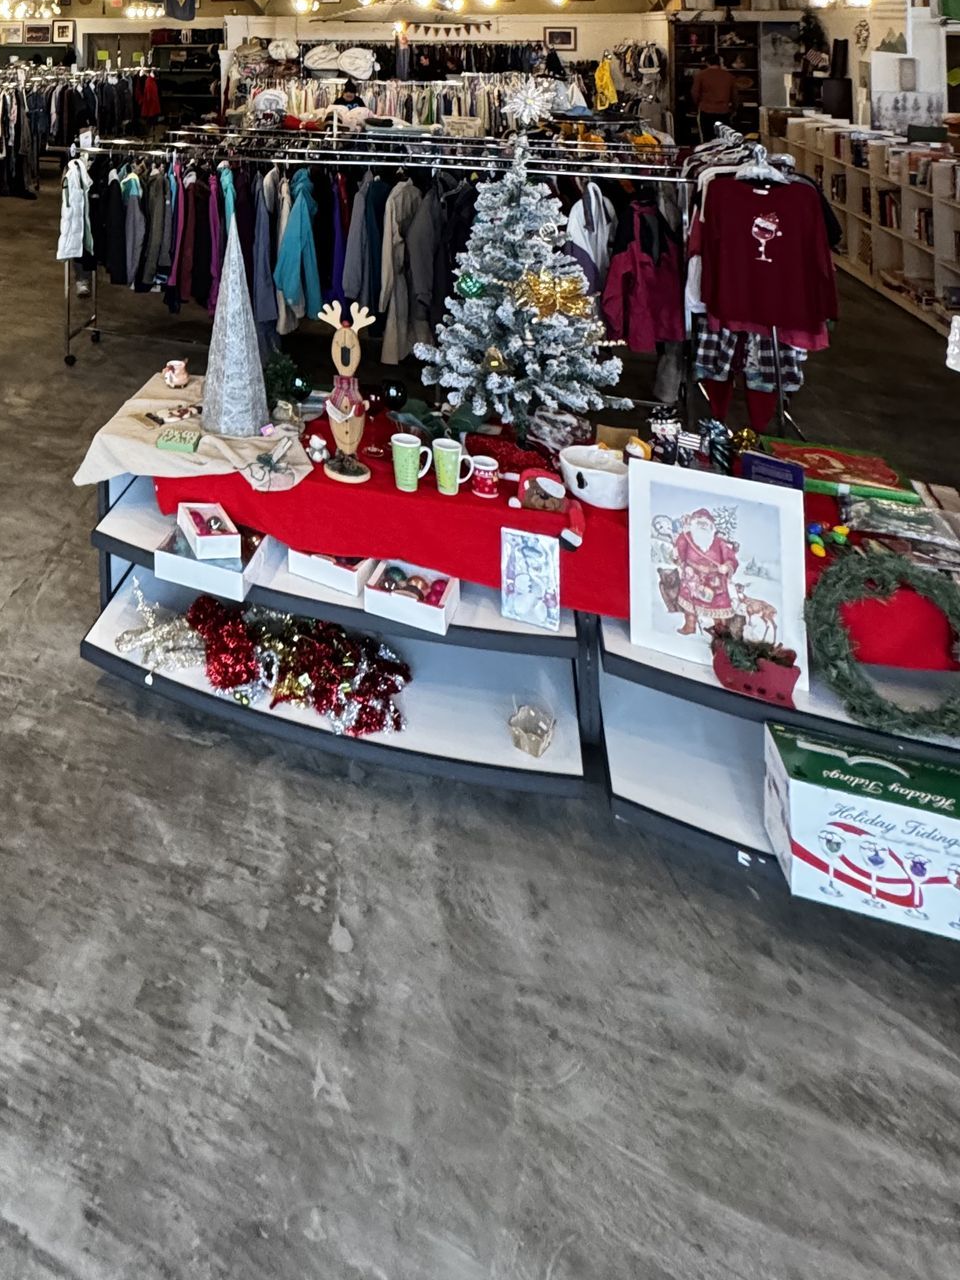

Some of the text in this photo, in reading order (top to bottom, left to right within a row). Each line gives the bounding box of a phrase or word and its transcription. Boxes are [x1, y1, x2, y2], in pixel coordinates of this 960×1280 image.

[822, 769, 956, 811] Holiday Tidings
[828, 803, 897, 834] Holiday
[901, 819, 960, 849] Tiding
